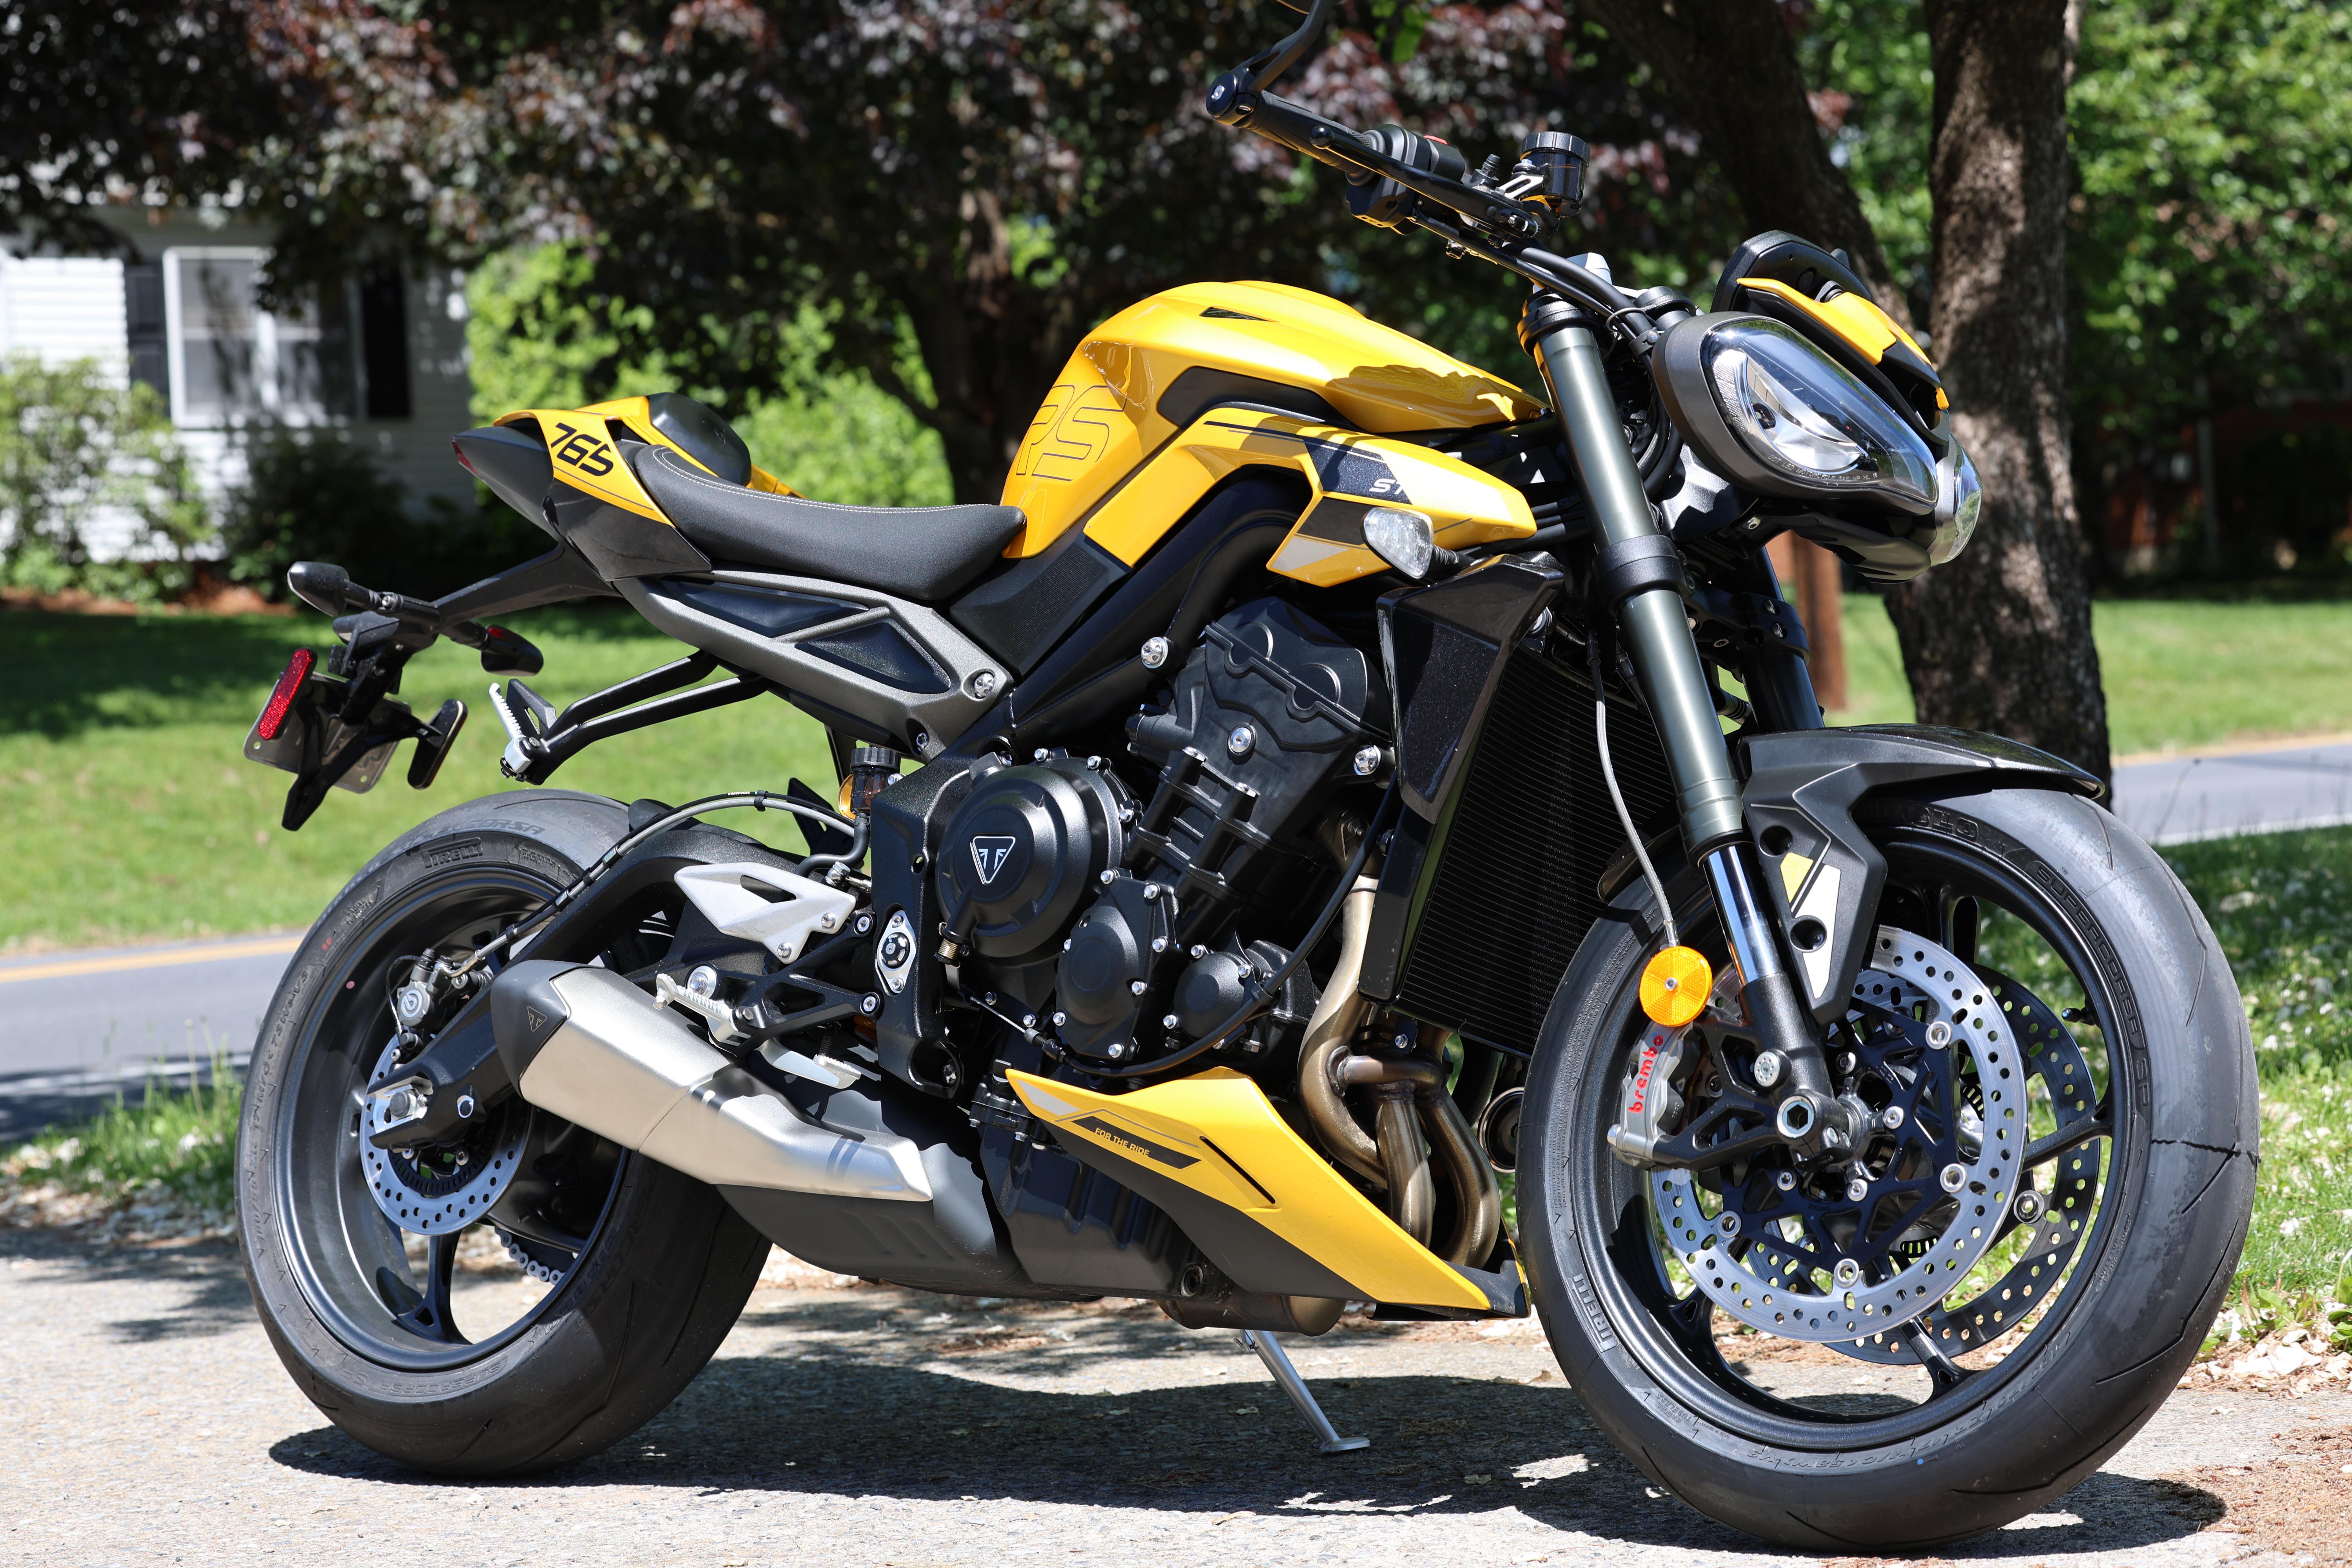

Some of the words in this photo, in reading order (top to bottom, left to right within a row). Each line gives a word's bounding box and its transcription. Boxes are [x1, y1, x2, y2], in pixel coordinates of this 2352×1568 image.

[551, 422, 613, 477] 765
[1016, 385, 1127, 481] RS
[1768, 454, 1782, 464] DOT
[1781, 461, 1795, 470] LED
[1795, 467, 1836, 480] MOTORCYCLE
[421, 837, 485, 871] PIRELLI
[2034, 865, 2141, 1038] SUPERCORSA
[2134, 1058, 2149, 1107] SP
[1628, 1034, 1664, 1114] brembo
[1094, 1127, 1112, 1140] FOR
[1112, 1135, 1129, 1147] THE
[1129, 1143, 1150, 1157] RIDE
[1565, 1271, 1619, 1356] PIRELLI
[1655, 1391, 1693, 1423] TUBELESS
[1655, 1401, 1682, 1425] RADIAL
